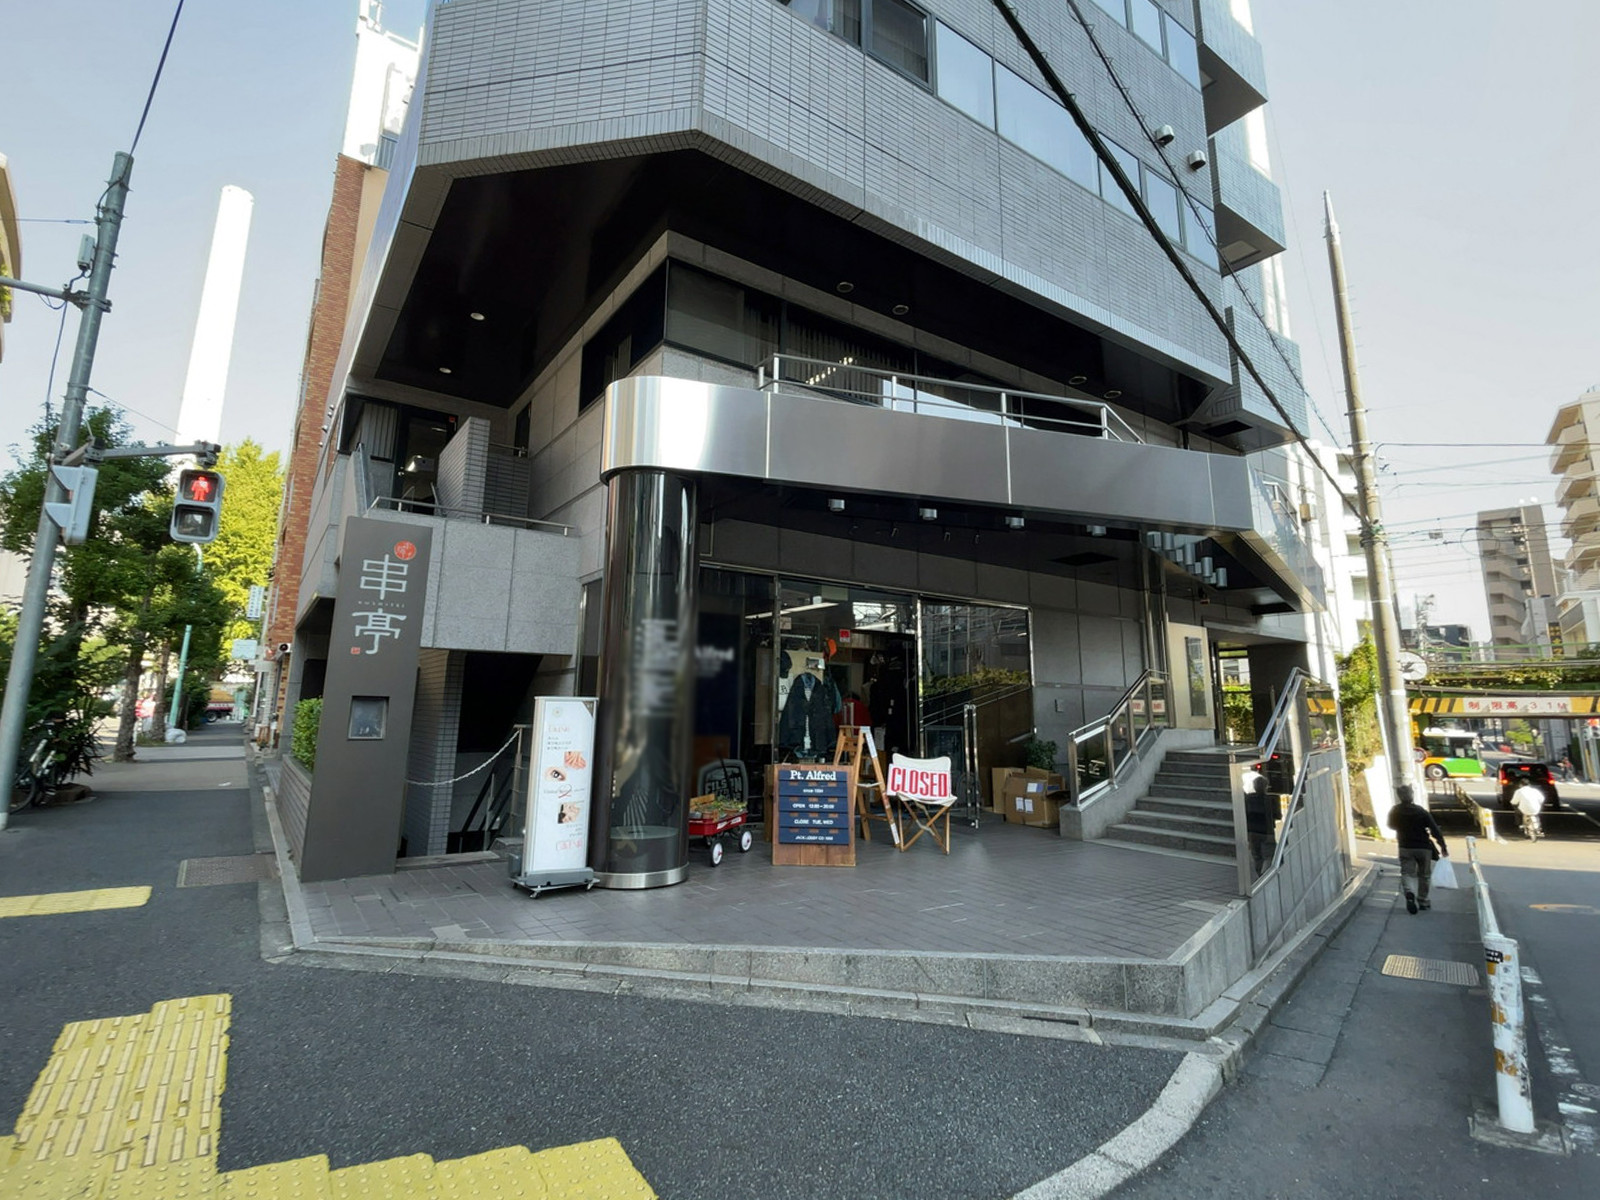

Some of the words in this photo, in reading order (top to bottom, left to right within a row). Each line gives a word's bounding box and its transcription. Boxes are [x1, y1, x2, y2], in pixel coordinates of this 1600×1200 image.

[352, 554, 408, 654] 串亭
[790, 769, 804, 780] Pt.
[805, 770, 836, 781] Alfred
[891, 767, 948, 798] CLOSED
